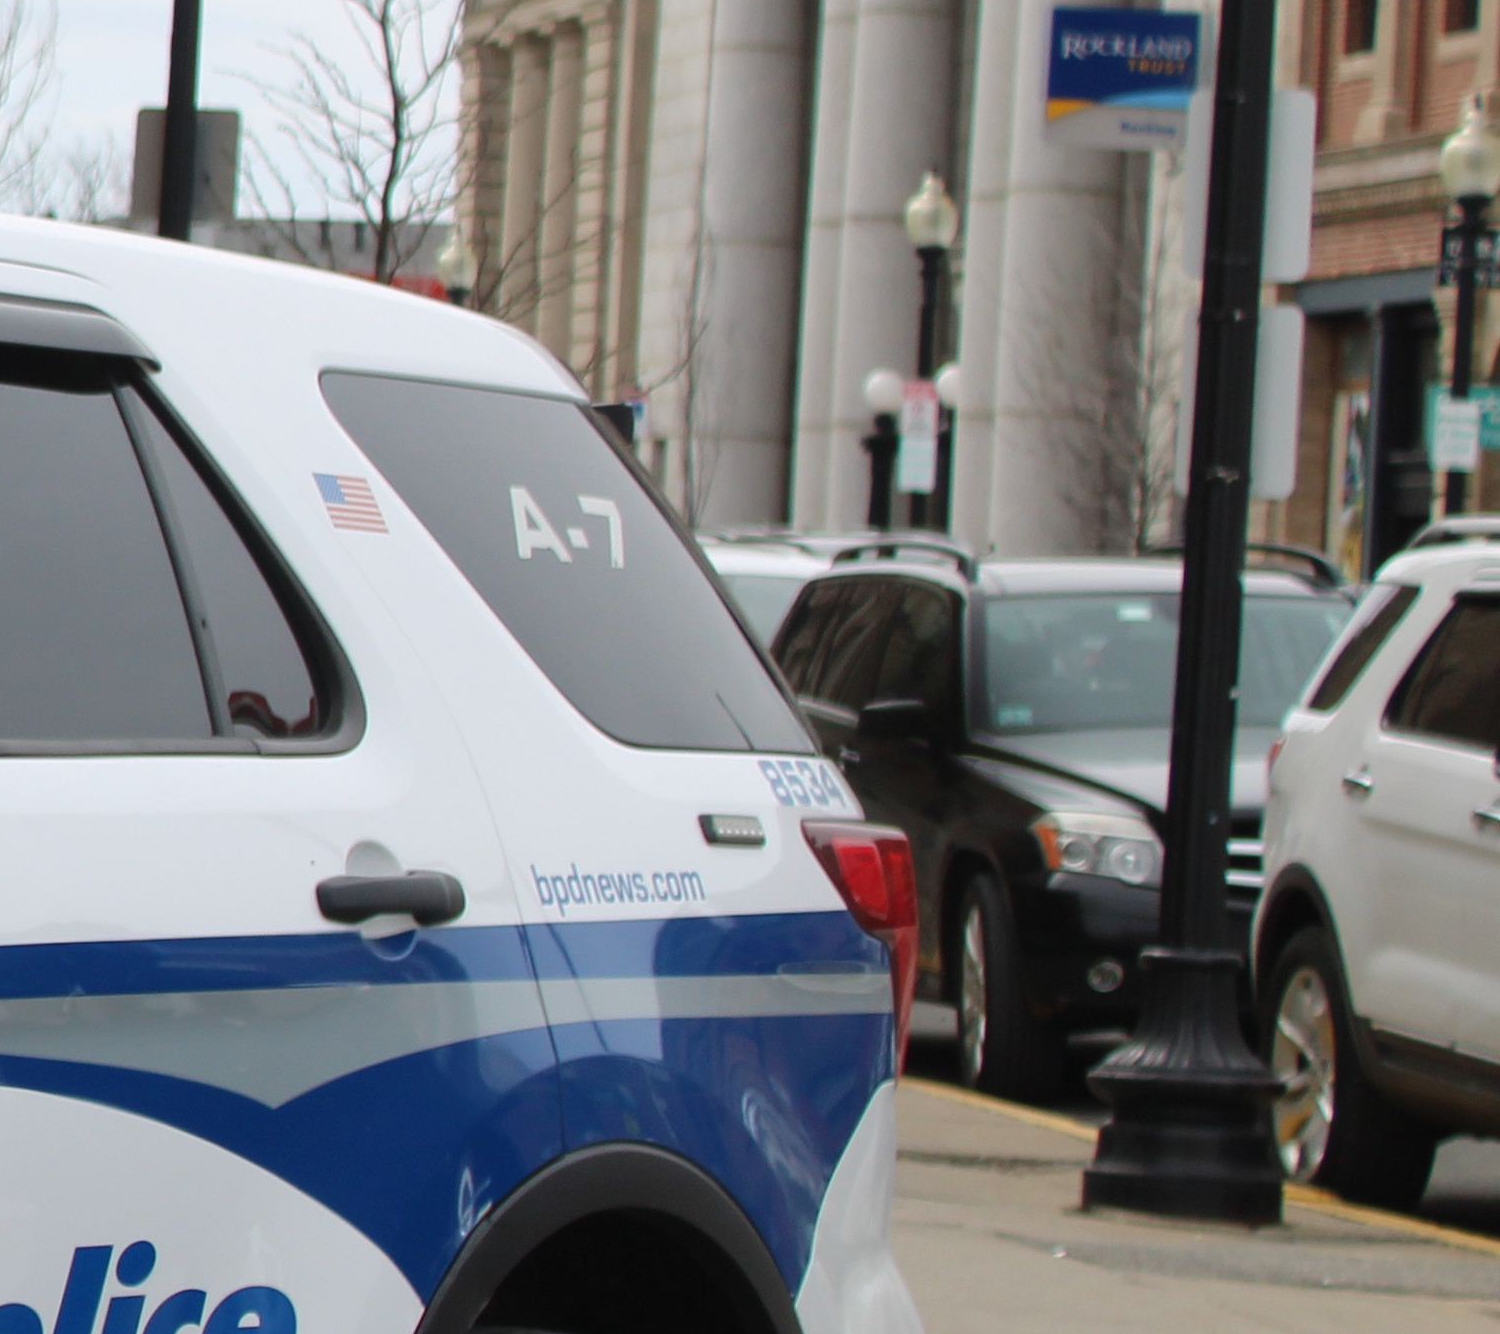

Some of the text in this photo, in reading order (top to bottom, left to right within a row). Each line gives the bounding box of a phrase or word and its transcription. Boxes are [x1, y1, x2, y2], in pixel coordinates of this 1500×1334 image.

[1061, 31, 1192, 61] ROCKLAND
[1128, 57, 1186, 75] TRUST
[510, 485, 624, 569] A-7
[757, 759, 847, 809] 8534
[530, 862, 706, 918] bpdnews.com
